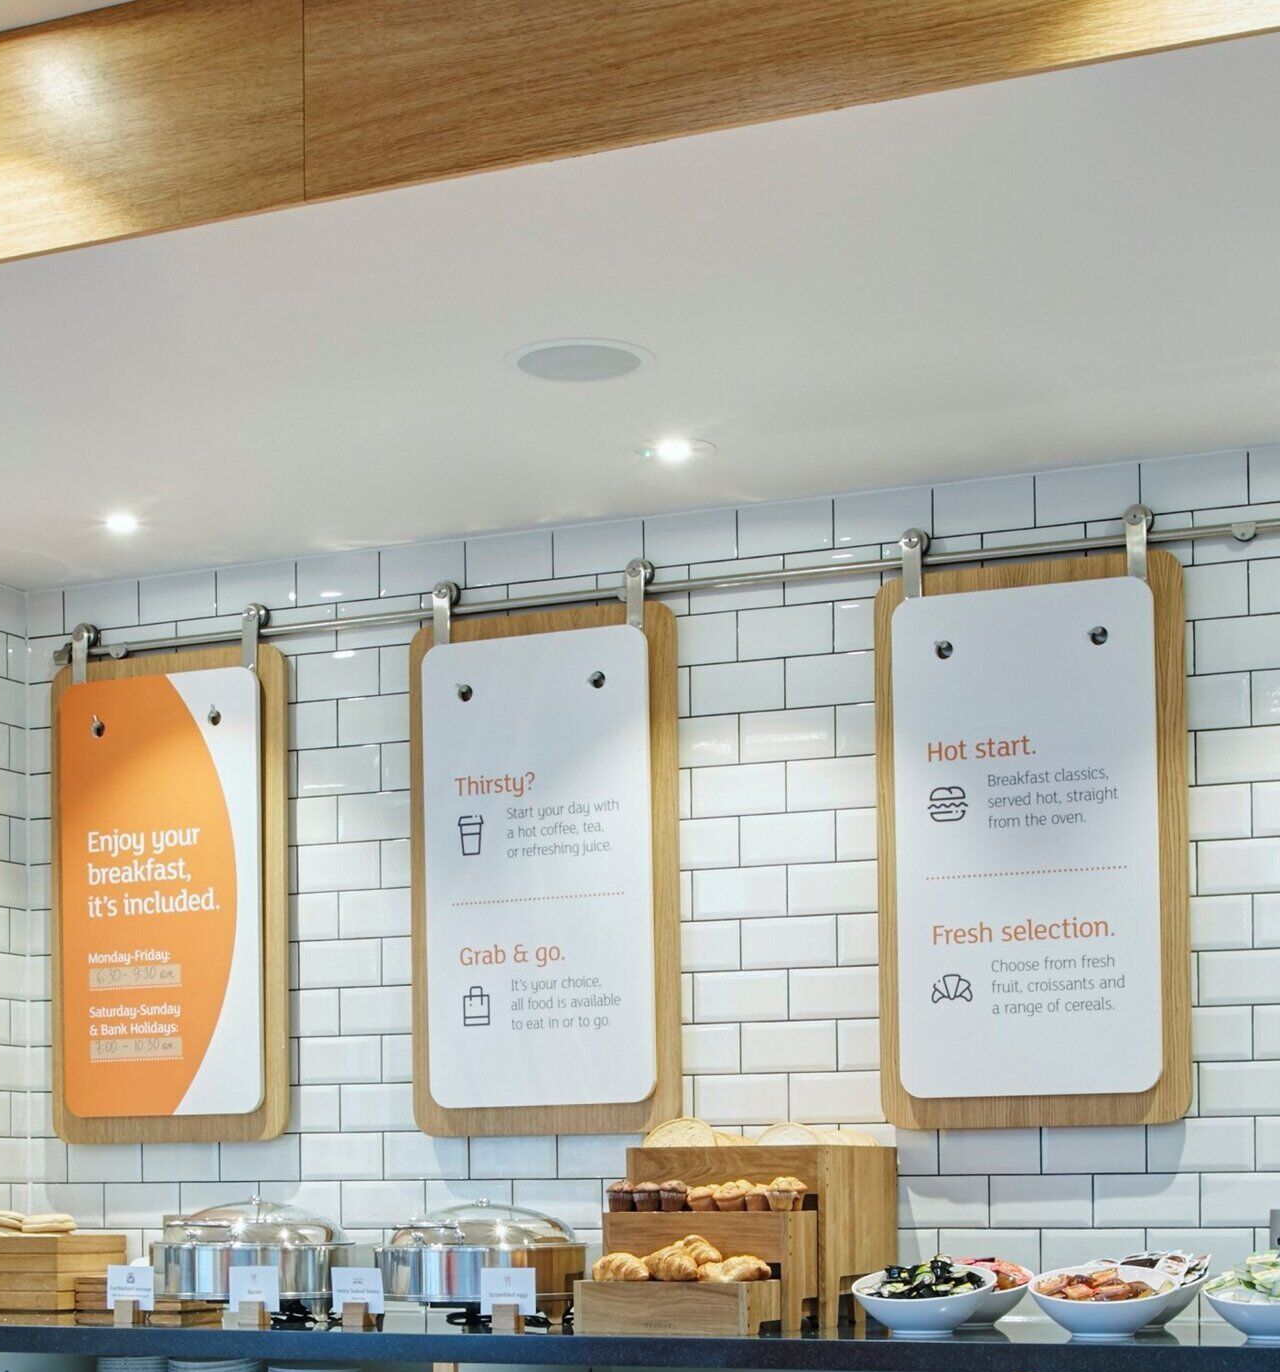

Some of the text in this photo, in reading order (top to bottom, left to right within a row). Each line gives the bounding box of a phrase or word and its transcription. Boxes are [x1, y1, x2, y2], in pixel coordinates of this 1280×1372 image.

[927, 735, 1037, 762] Hot start.
[454, 771, 536, 798] Thirsty?
[987, 766, 1109, 787] Breakfast classics,
[987, 786, 1118, 809] served hot, straight
[506, 799, 620, 821] Start your day with
[988, 811, 1087, 829] from the oven.
[507, 828, 515, 839] a
[517, 826, 537, 838] hot
[540, 822, 580, 836] coffee,
[87, 826, 201, 858] Enjoy your
[507, 839, 613, 859] or refreshing juice.
[87, 857, 192, 886] breakfast,
[87, 886, 221, 918] it's included.
[932, 916, 1116, 945] Fresh selection.
[88, 948, 172, 966] Monday-Friday:
[459, 943, 566, 968] Grab & go.
[991, 954, 1116, 973] Choose from fresh
[511, 976, 602, 994] It's your choice,
[991, 974, 1126, 994] fruit, croissants and
[88, 1002, 182, 1020] Saturday-Sunday
[510, 993, 622, 1011] all food is available
[992, 996, 1116, 1017] a range of cereals.
[89, 1020, 180, 1037] & Bank Holidays:
[511, 1016, 612, 1030] to eat in or to go.
